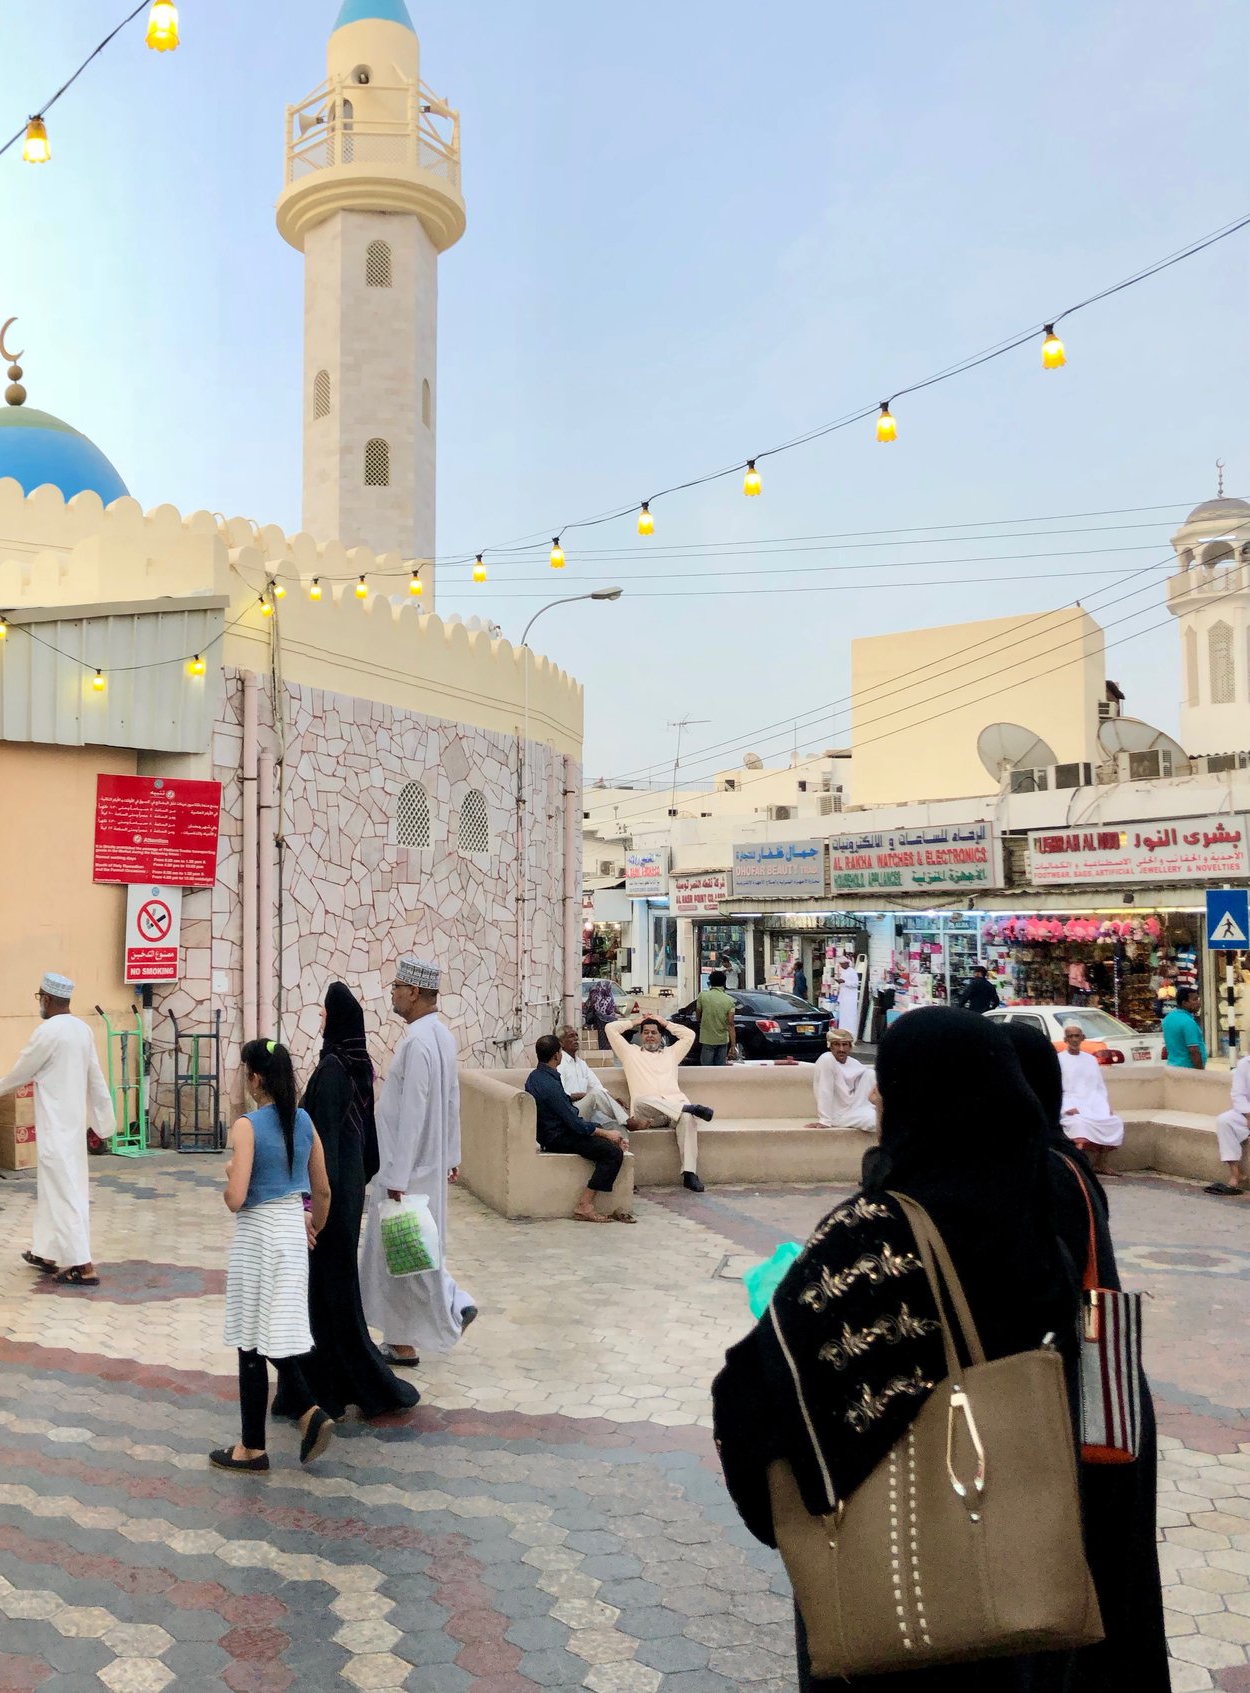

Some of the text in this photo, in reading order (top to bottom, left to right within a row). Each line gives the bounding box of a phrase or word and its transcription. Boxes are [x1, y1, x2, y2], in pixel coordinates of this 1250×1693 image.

[889, 837, 895, 851] و
[1082, 831, 1096, 851] AL
[1097, 831, 1127, 850] NOO
[1134, 822, 1242, 852] بشرى النور
[756, 844, 785, 863] ظفار
[833, 856, 844, 872] AL
[876, 851, 915, 868] WATCHES
[917, 850, 923, 866] &
[925, 847, 988, 866] ELECTRONICS
[735, 865, 765, 877] DHUFAR
[767, 863, 799, 876] BEAUTY
[1095, 867, 1135, 876] ARTIFICIAL
[1139, 865, 1182, 874] JEWELLERY
[1186, 865, 1193, 873] &
[1196, 863, 1241, 872] NOVELTIES
[155, 950, 175, 961] ممنوع
[130, 967, 175, 976] NO SMOKING
